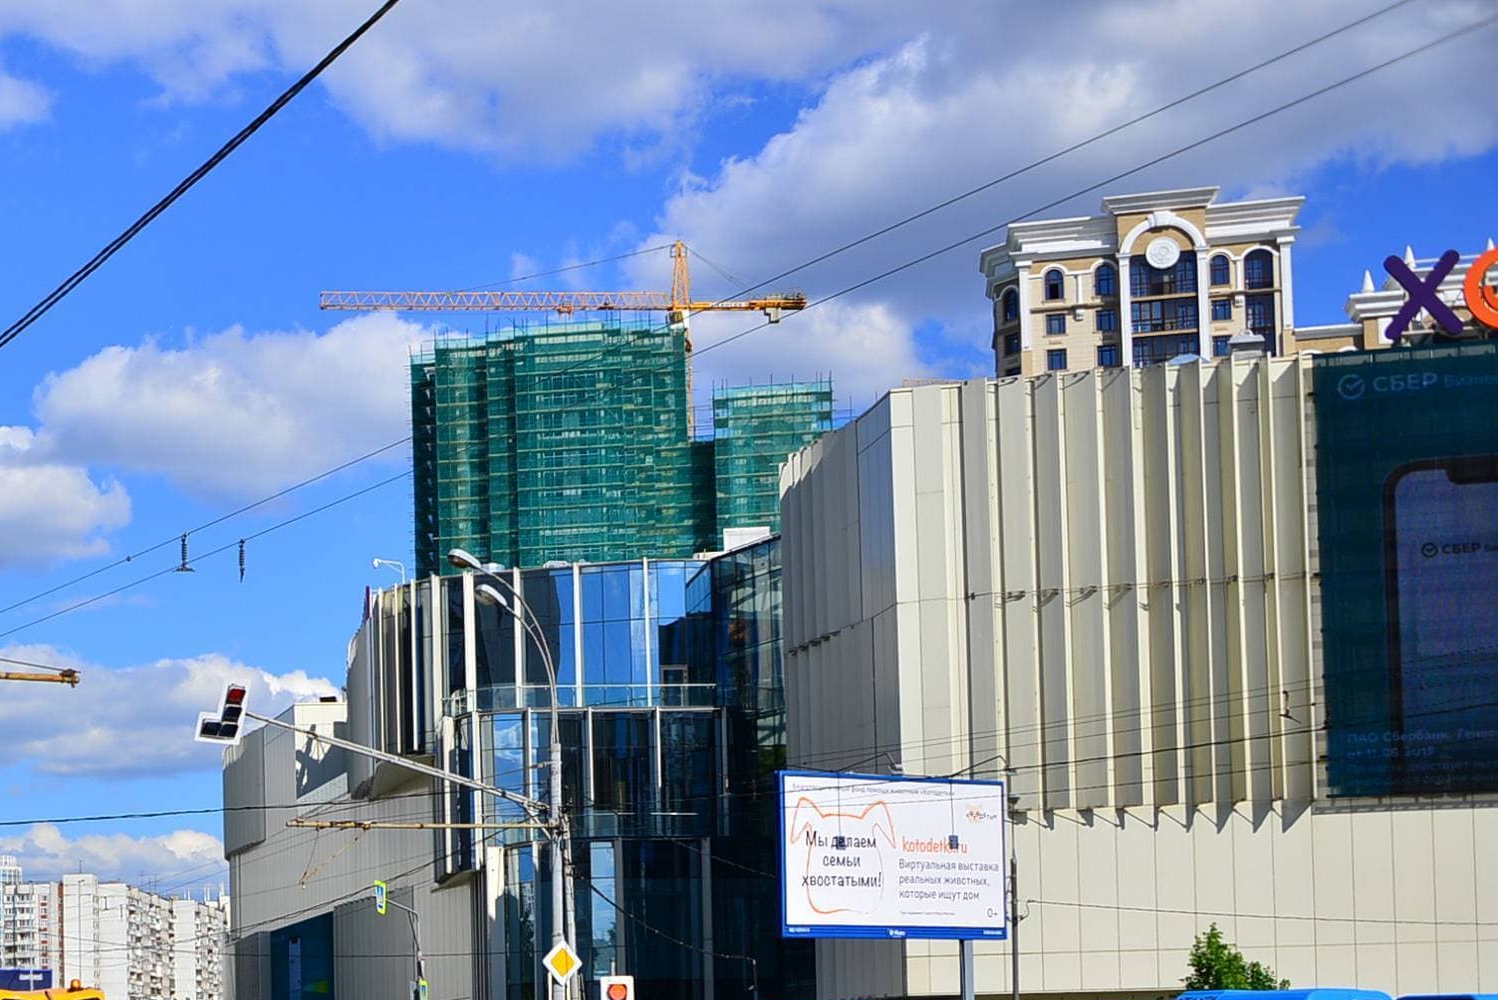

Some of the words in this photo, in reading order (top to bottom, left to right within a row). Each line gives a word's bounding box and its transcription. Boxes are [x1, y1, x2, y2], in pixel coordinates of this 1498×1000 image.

[1373, 372, 1437, 392] СБЕР
[1442, 543, 1480, 554] СБЕР
[805, 830, 828, 847] Мы
[822, 855, 861, 867] семьи
[898, 858, 956, 872] Виртуальная
[958, 863, 999, 872] выставка
[801, 871, 882, 887] хвостатыми!
[898, 875, 942, 886] реальных
[944, 877, 991, 887] животных,
[898, 890, 937, 901] которые
[938, 891, 961, 902] ищут
[962, 892, 980, 901] дом
[986, 907, 999, 918] 0+
